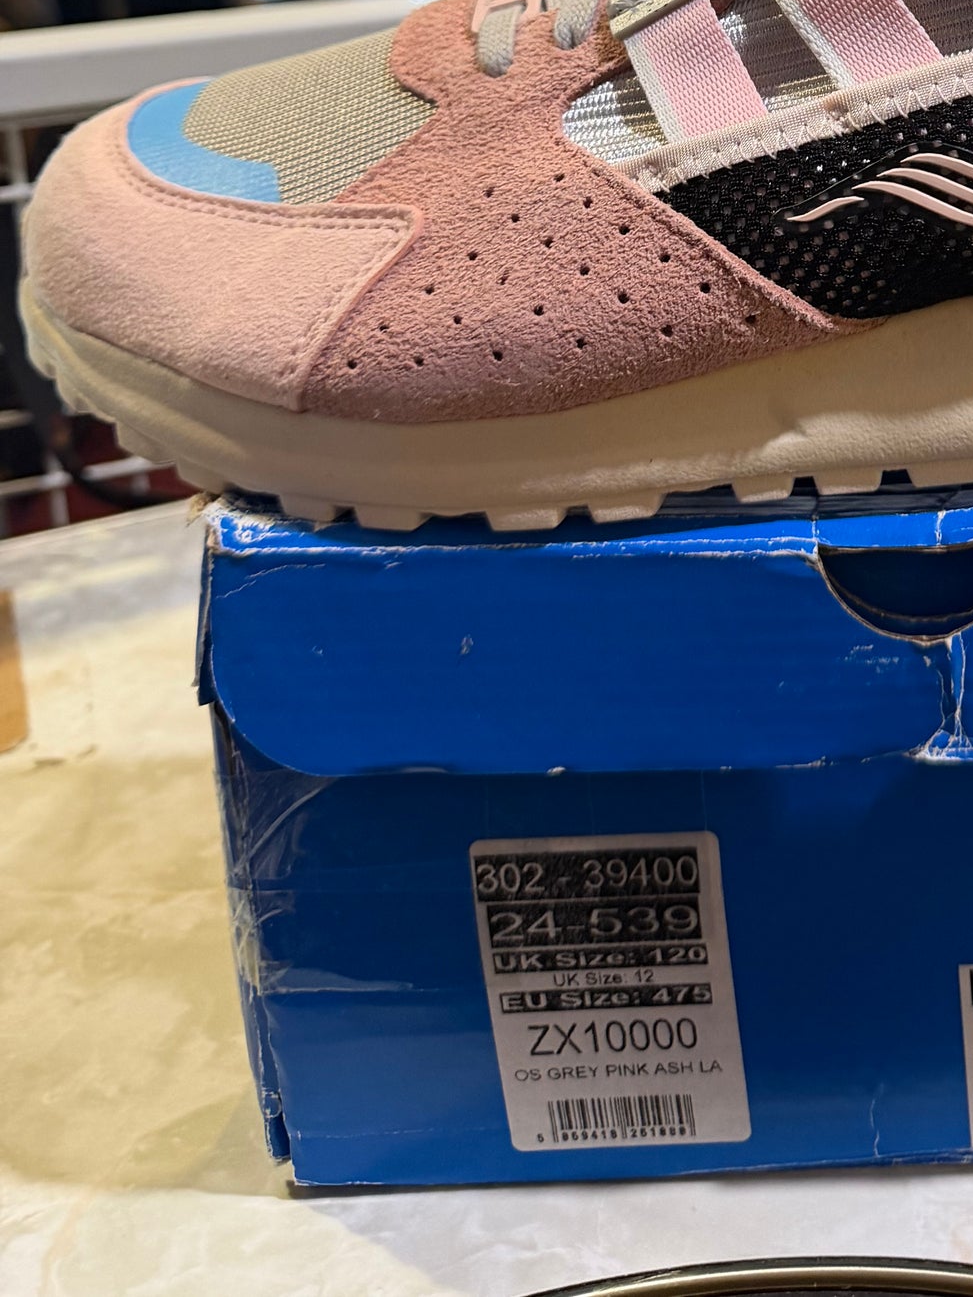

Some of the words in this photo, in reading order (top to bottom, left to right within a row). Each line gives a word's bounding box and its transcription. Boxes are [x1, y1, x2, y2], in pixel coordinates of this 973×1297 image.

[476, 862, 546, 894] 302
[582, 855, 698, 890] 39400
[490, 904, 699, 941] 24-539
[494, 953, 544, 971] UK
[653, 945, 706, 964] 120
[553, 973, 581, 988] UK
[585, 971, 628, 986] Size:
[635, 969, 655, 984] 12
[501, 993, 548, 1012] EU
[652, 986, 711, 1003] 475
[528, 1018, 698, 1056] ZX10000
[514, 1068, 542, 1082] OS
[547, 1065, 599, 1080] GREY
[605, 1063, 650, 1078] PINK
[654, 1061, 694, 1075] ASH
[699, 1060, 723, 1073] LA
